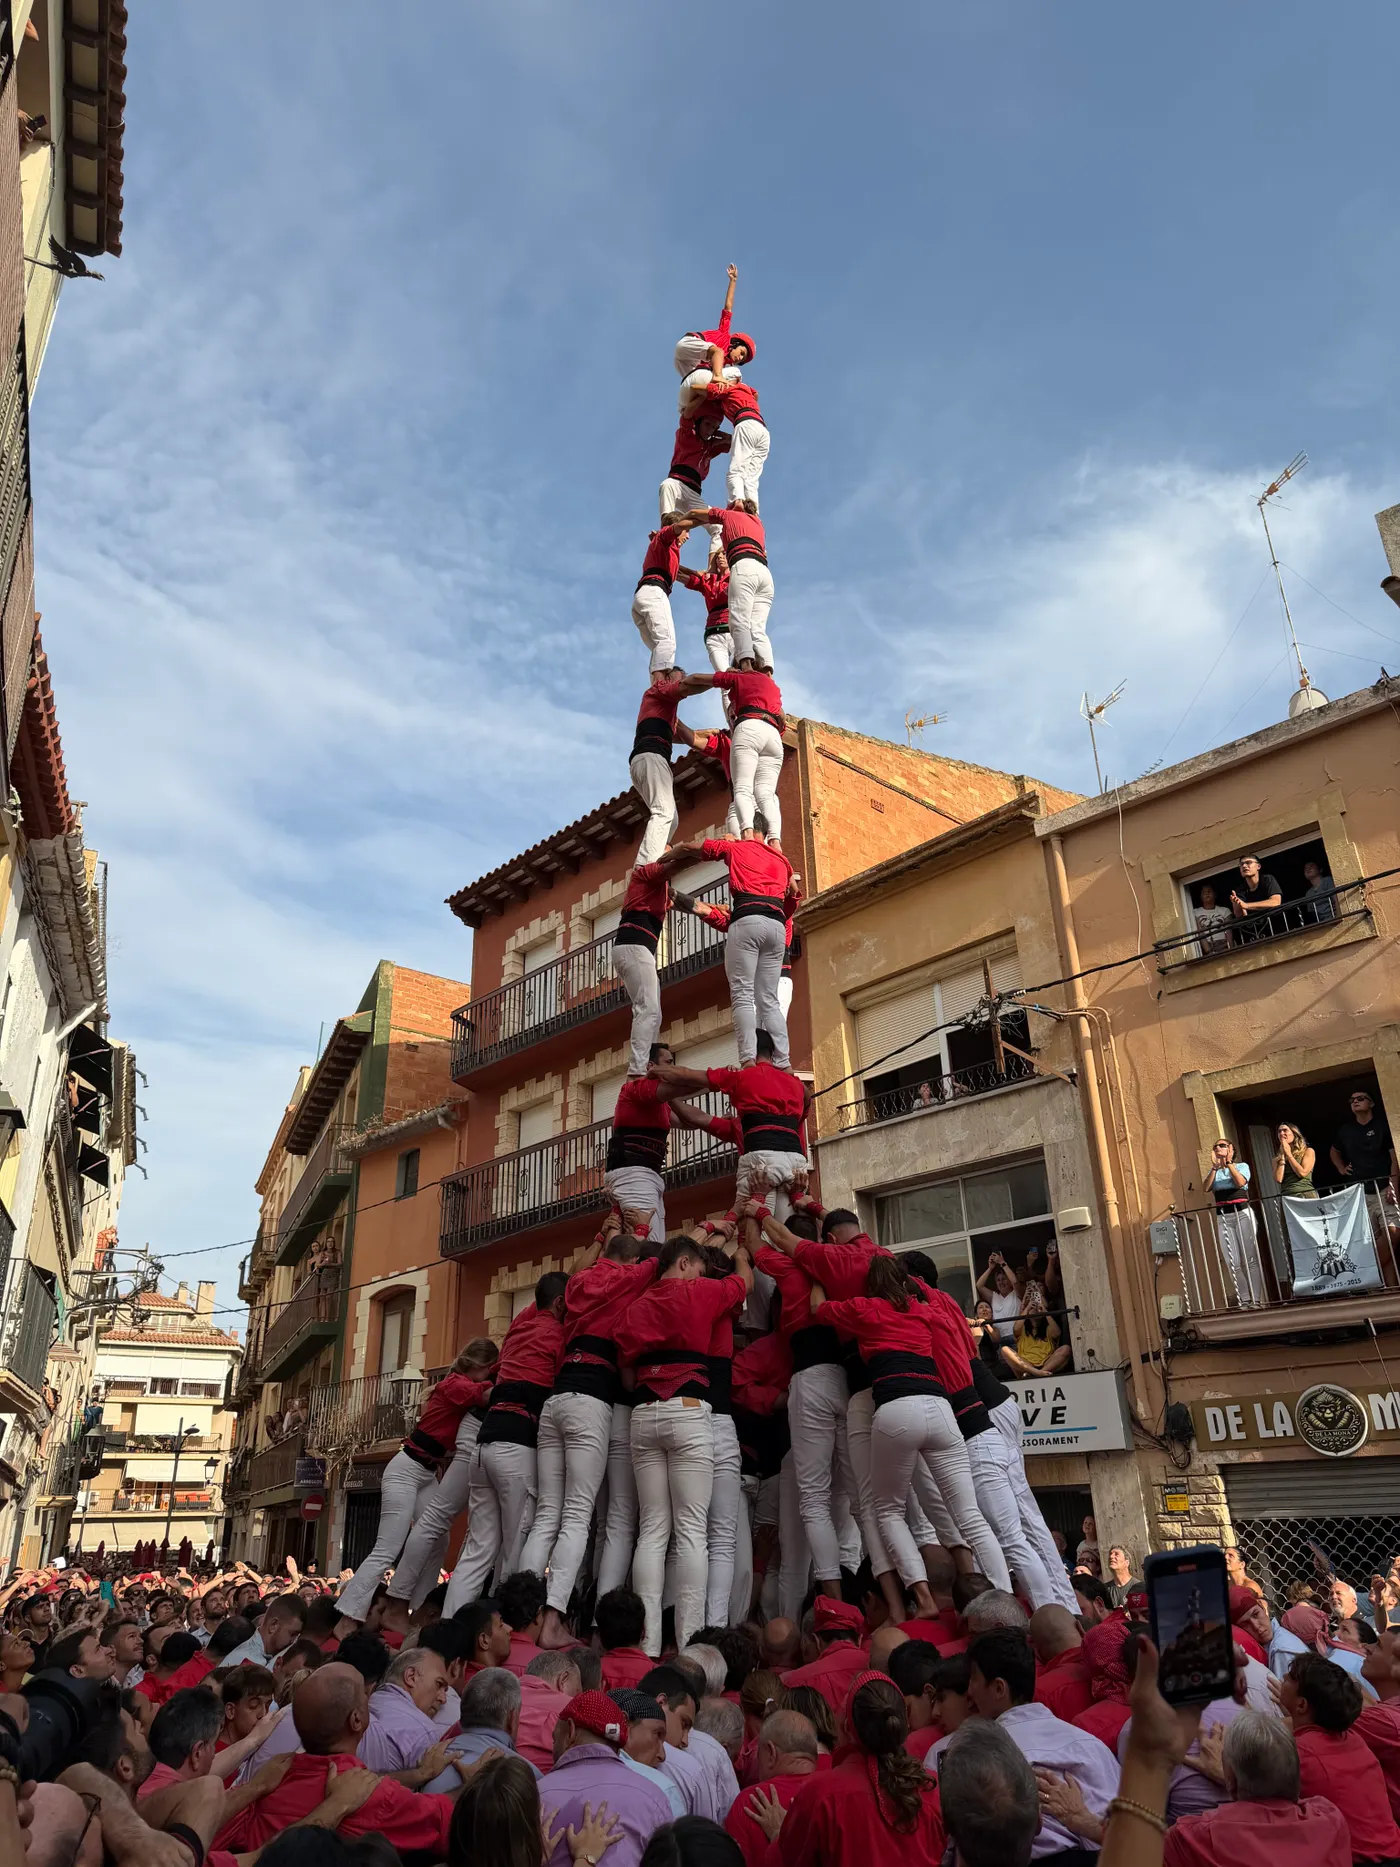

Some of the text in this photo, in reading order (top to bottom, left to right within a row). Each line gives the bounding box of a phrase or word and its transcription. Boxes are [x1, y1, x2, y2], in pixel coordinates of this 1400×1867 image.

[1347, 1278, 1362, 1286] 2015
[1204, 1404, 1247, 1442] DE
[1253, 1401, 1295, 1438] LA
